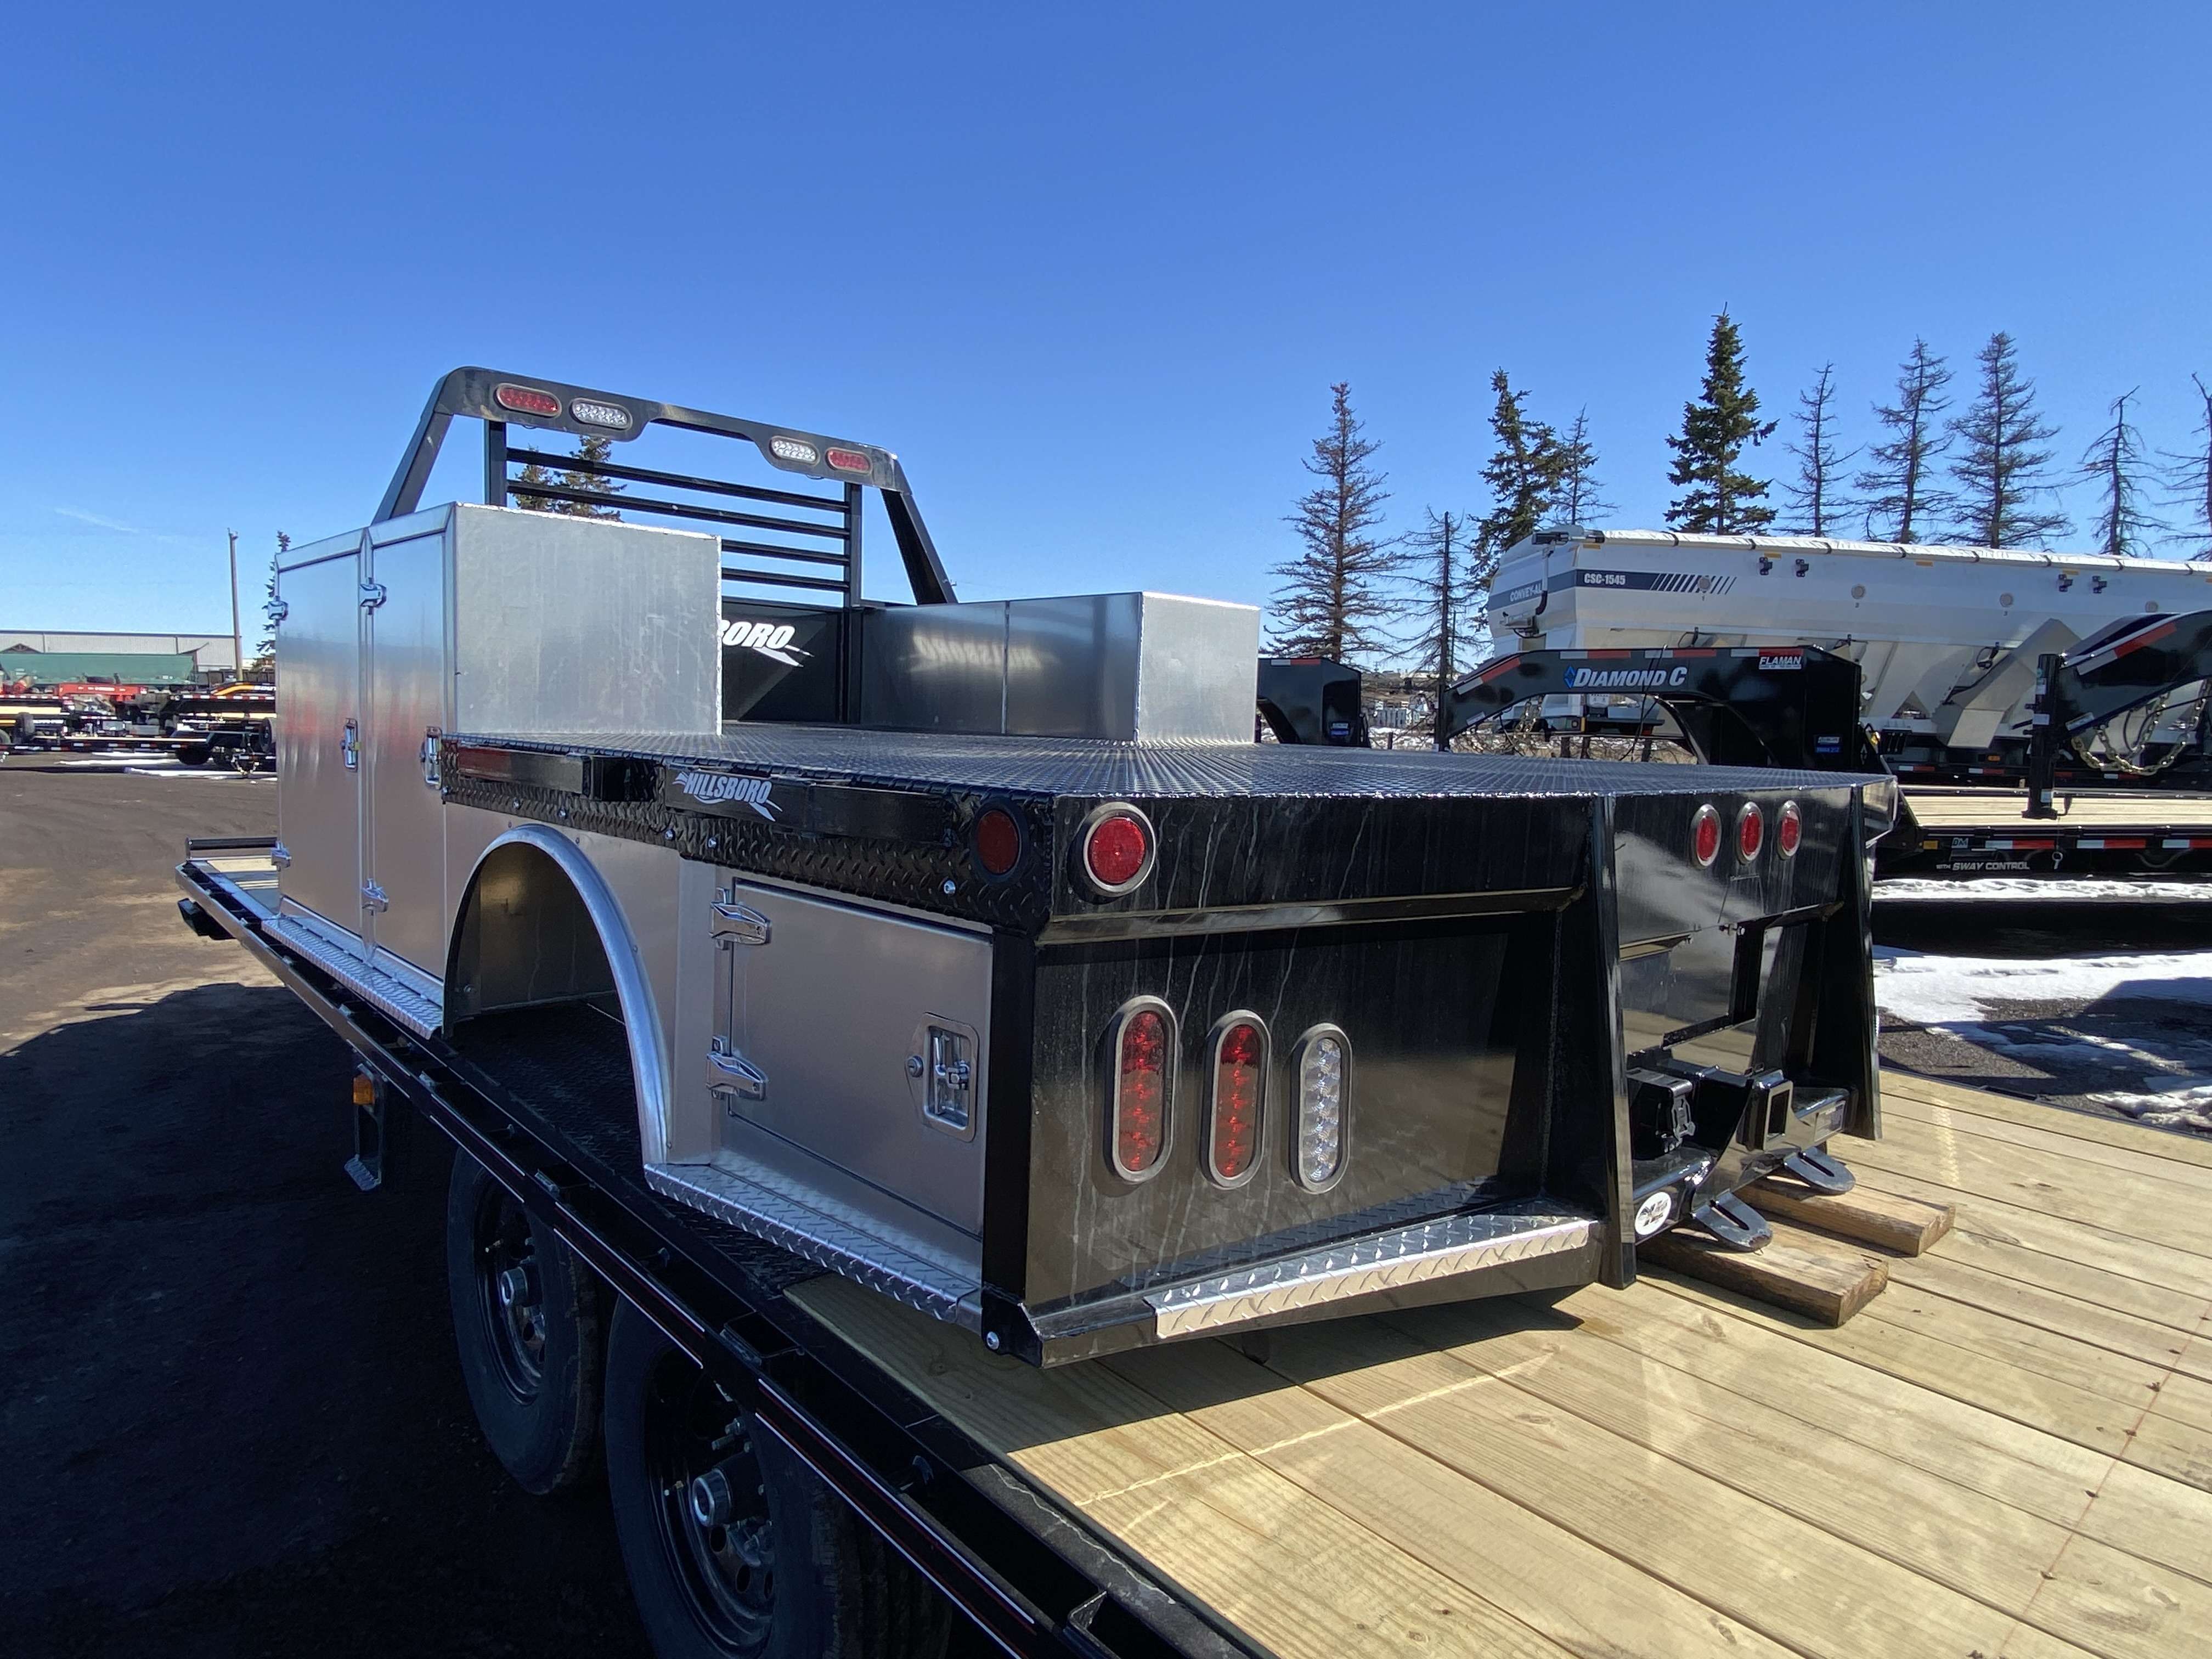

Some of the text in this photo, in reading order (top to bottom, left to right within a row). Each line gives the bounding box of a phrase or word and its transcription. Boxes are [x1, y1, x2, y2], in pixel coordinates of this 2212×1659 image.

[1584, 573, 1626, 585] CSC-1545
[1510, 583, 1543, 602] CONVEY-AL
[1759, 656, 1802, 665] FLAMAN
[1572, 666, 1688, 687] DIAMOND C
[684, 772, 772, 803] HILLSBORO
[1985, 862, 2030, 870] CONTROL
